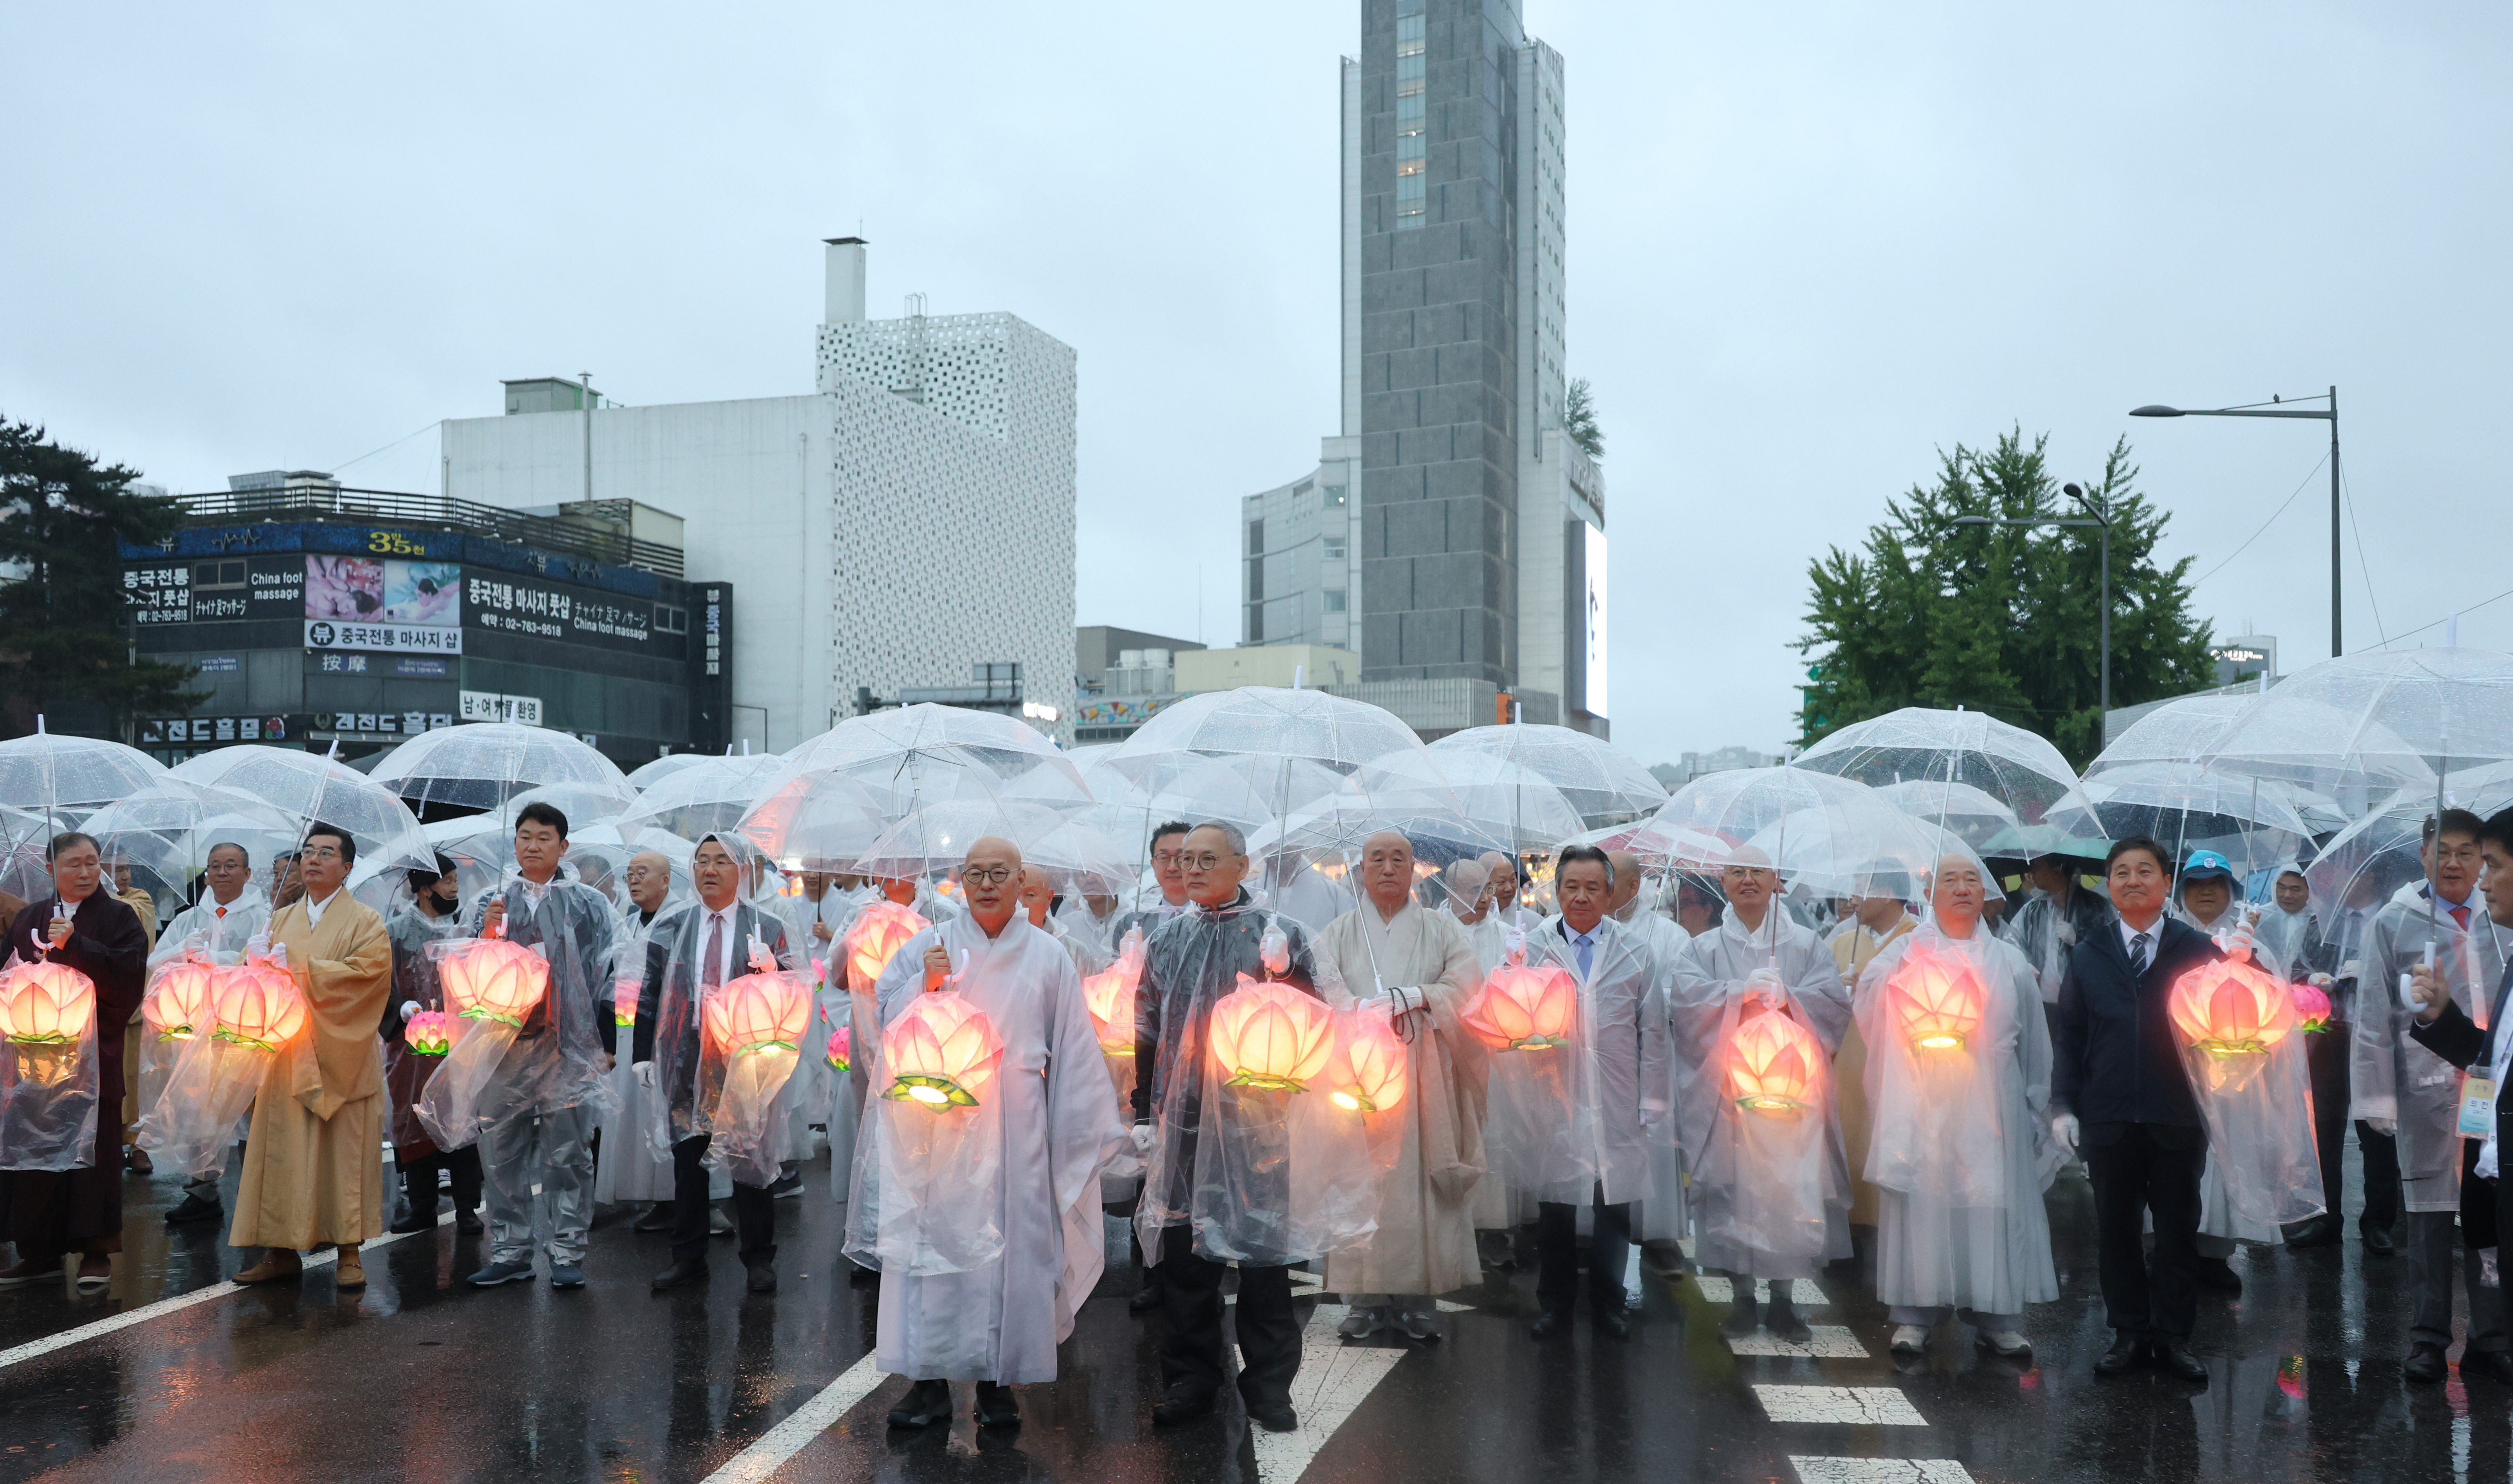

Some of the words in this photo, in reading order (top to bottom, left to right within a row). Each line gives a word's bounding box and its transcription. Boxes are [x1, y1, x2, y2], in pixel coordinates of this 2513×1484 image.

[123, 568, 189, 588] 중국전통
[251, 572, 280, 585] China
[283, 571, 302, 584] foot
[163, 589, 189, 607] 풋샵
[254, 589, 299, 600] massage
[469, 578, 513, 610] 중국전통
[516, 587, 547, 616] 마사지
[550, 593, 570, 619] 풋샵
[313, 625, 331, 644] 뷰
[341, 627, 395, 646] 중국전통
[400, 631, 439, 648] 마사지
[445, 632, 458, 648] 샵
[505, 617, 562, 637] 02-763-9518
[574, 616, 597, 632] China
[599, 620, 614, 634] foot
[615, 625, 648, 641] massage
[322, 654, 367, 672] 按摩
[518, 700, 537, 721] 환영
